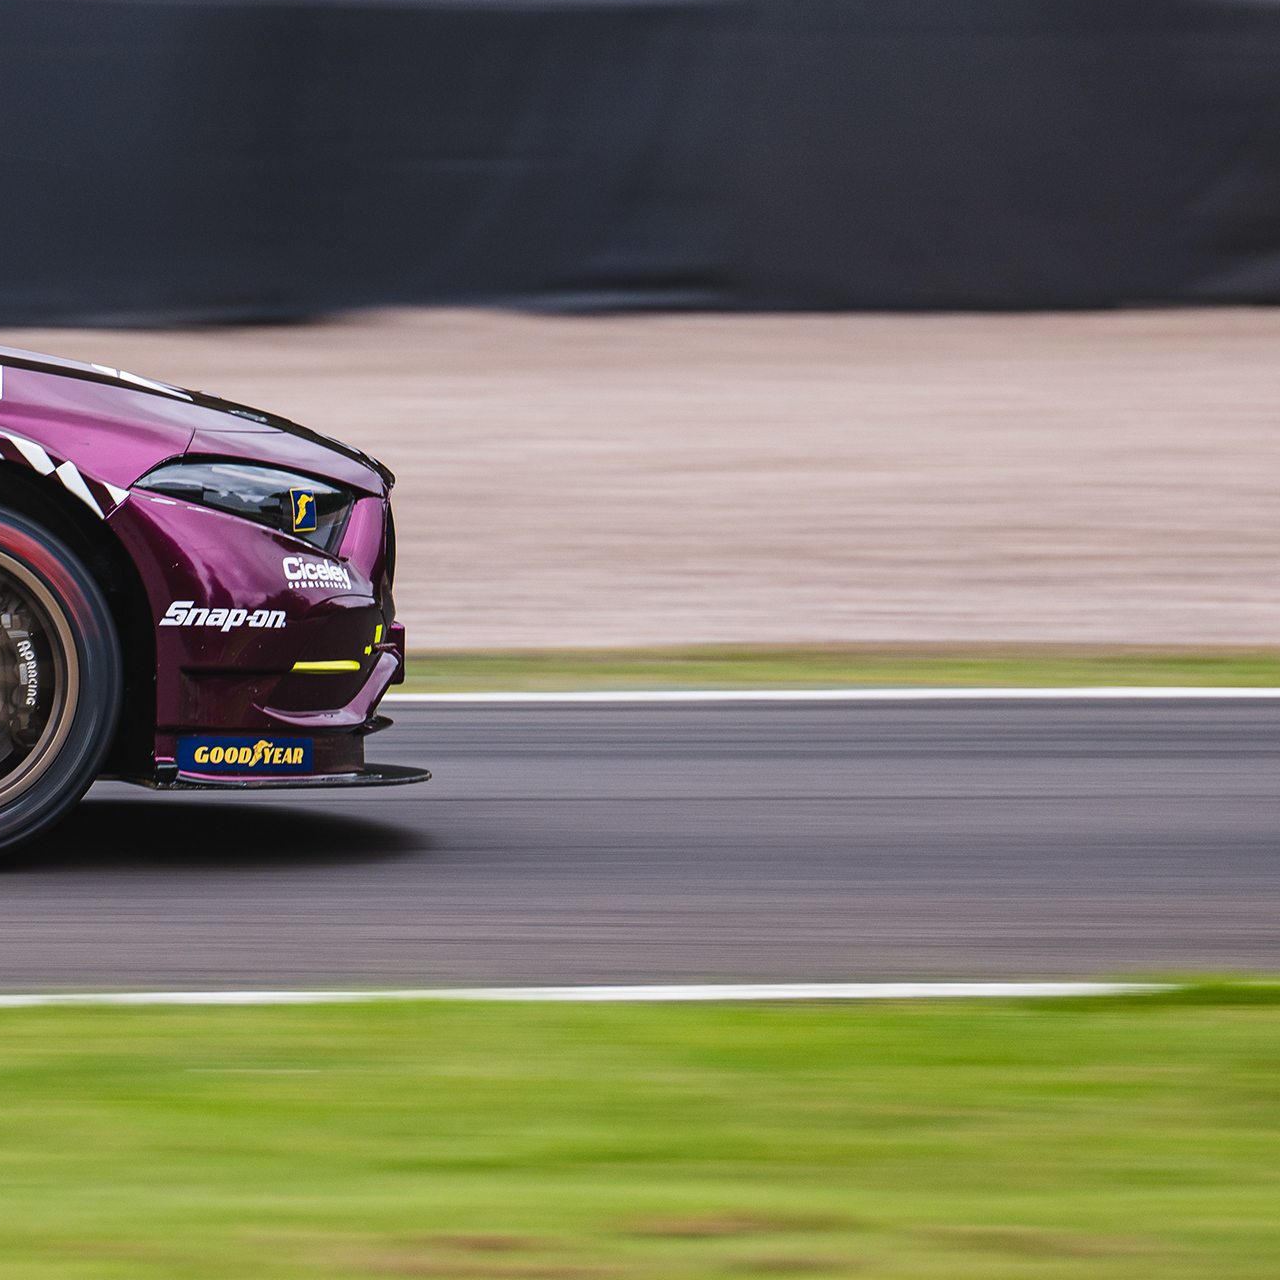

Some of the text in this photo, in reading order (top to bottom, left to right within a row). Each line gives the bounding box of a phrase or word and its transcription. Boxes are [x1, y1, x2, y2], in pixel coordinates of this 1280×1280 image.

[282, 557, 352, 590] Ciceley
[159, 600, 286, 632] Snap-on
[25, 661, 39, 706] RACING
[194, 739, 304, 767] GOODYEAR
